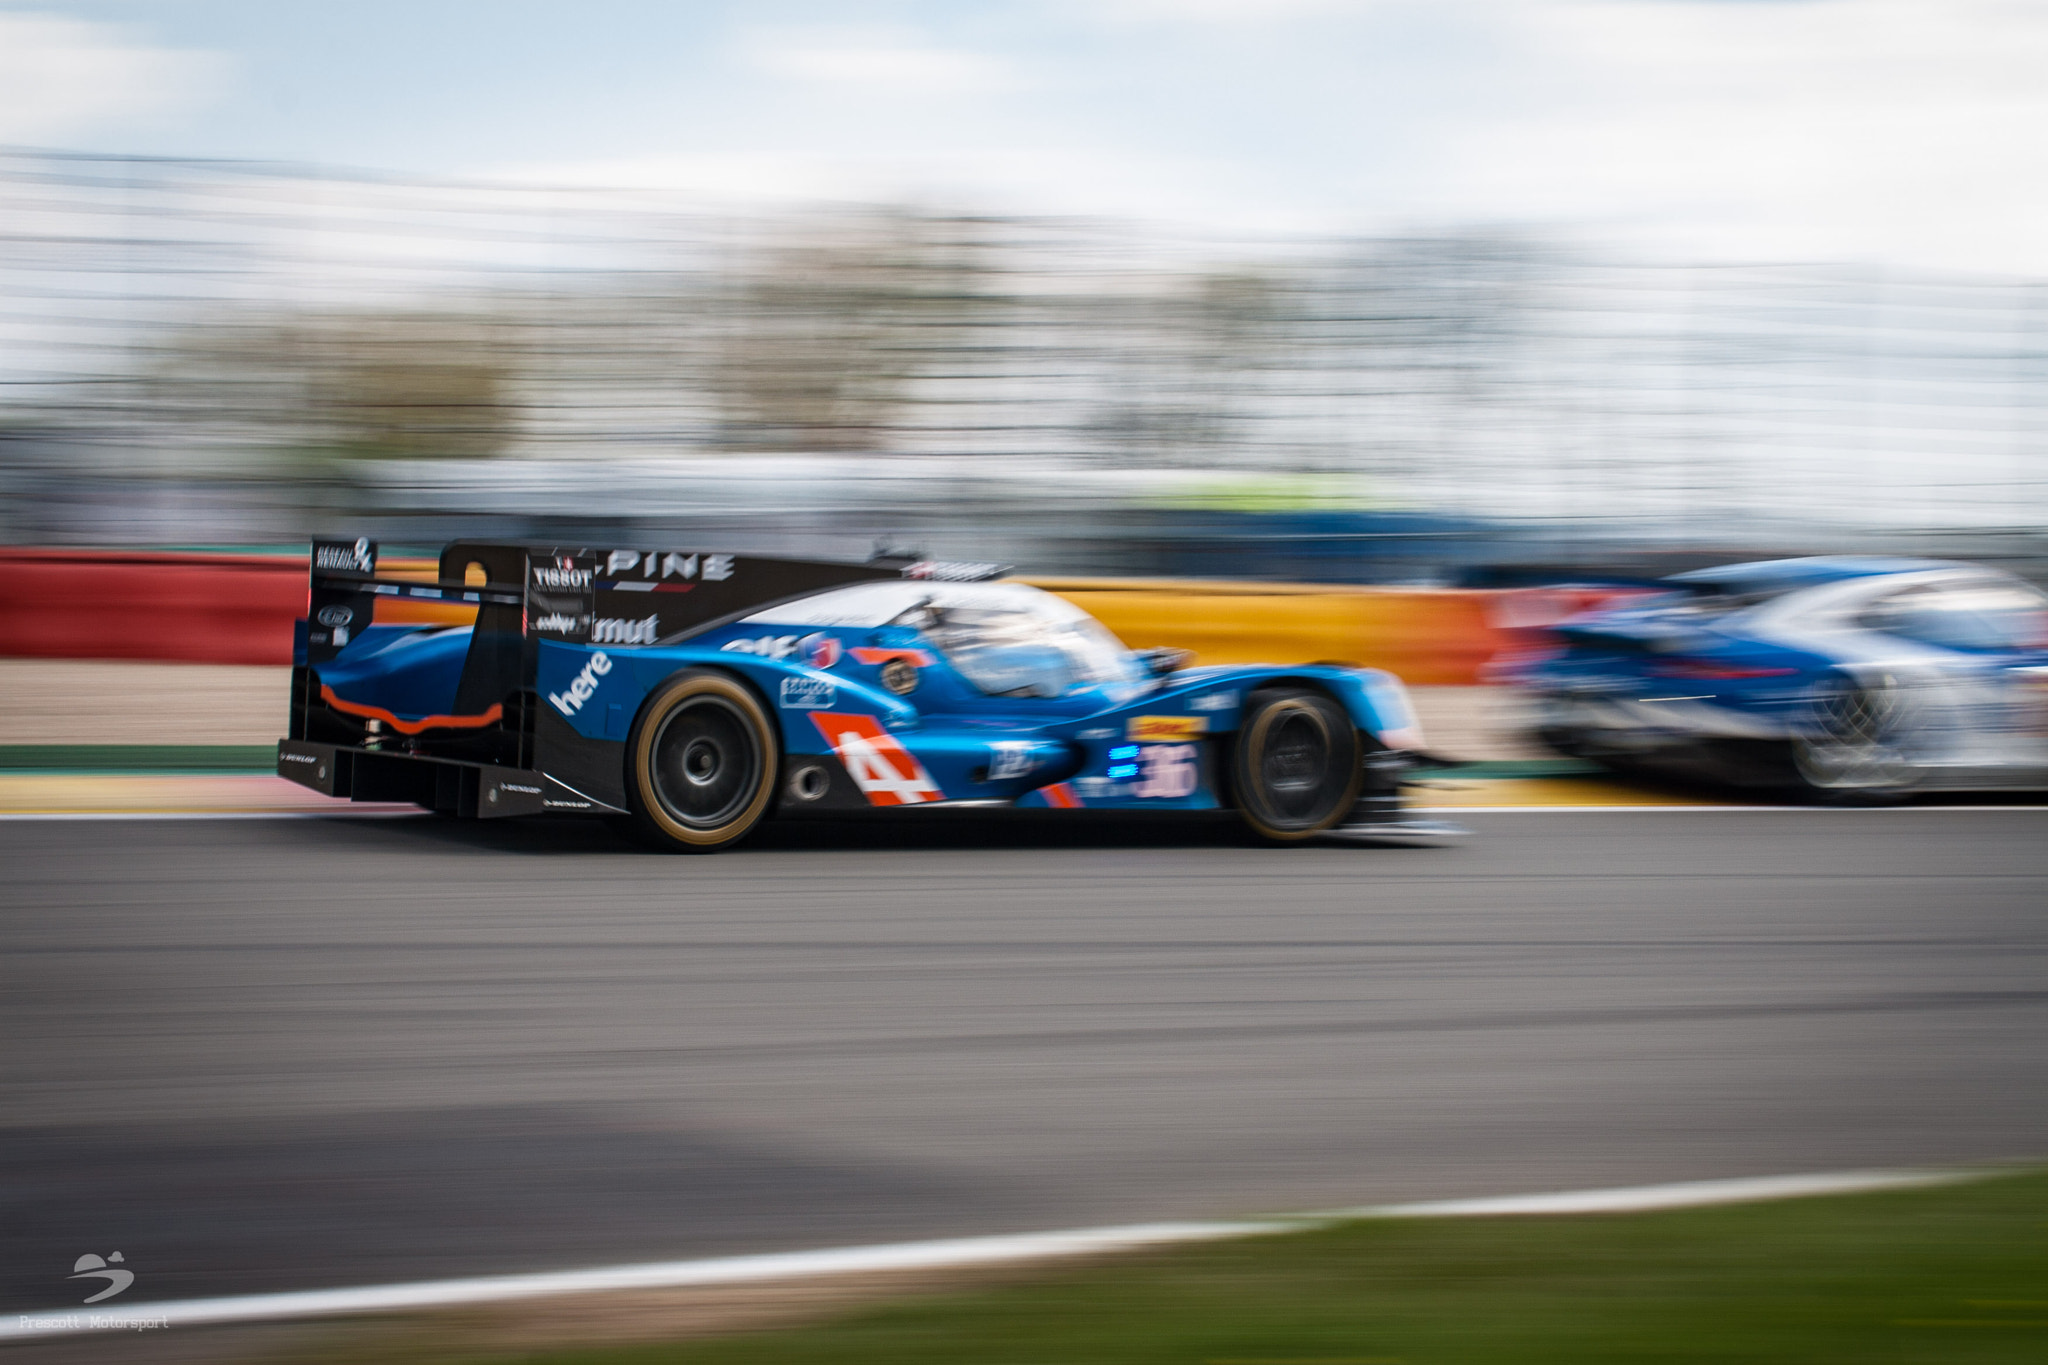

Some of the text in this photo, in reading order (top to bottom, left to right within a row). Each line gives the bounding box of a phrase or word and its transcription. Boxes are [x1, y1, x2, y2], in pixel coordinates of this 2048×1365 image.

[533, 567, 592, 588] TISSOT
[594, 550, 734, 581] PINE
[548, 650, 613, 717] here
